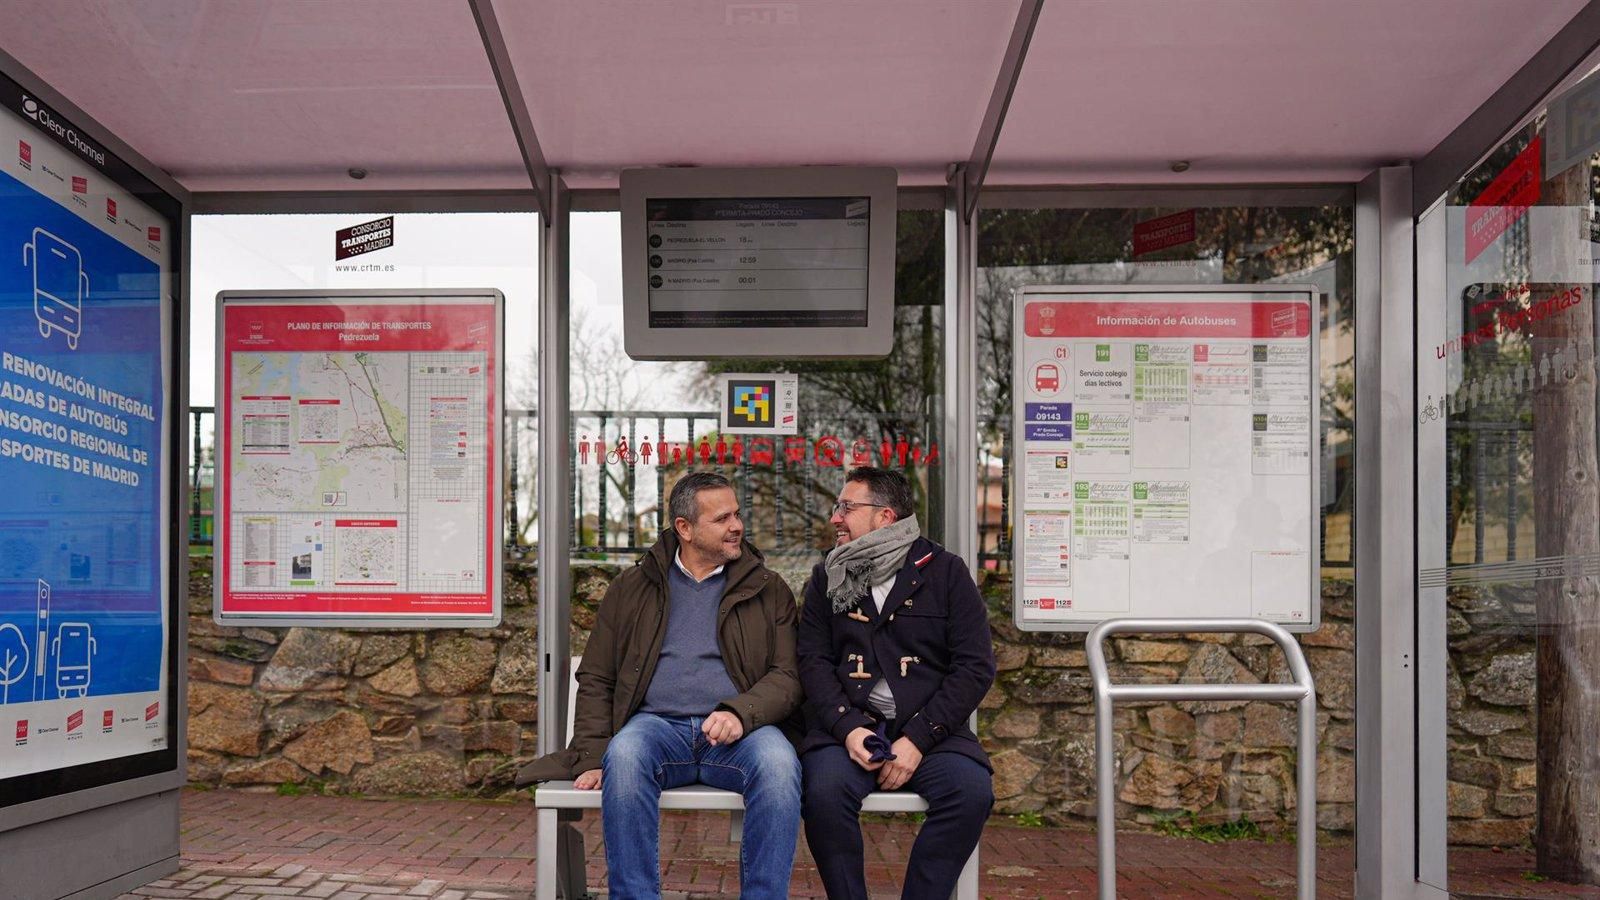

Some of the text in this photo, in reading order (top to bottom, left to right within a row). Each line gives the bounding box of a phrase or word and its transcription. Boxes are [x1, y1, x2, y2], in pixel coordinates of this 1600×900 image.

[38, 109, 105, 166] Clear Channel
[351, 218, 391, 236] CONSORCIO
[341, 228, 391, 249] TRANSPORTES
[364, 237, 391, 252] MADRID
[335, 264, 395, 272] www.crtm.es
[287, 320, 432, 330] PLANO DE INFORMACIÓN DE TRANSPORTES
[1096, 315, 1237, 326] Información de Autobuses
[338, 332, 380, 341] Pedrezuela
[1056, 347, 1067, 359] C1
[1079, 369, 1127, 379] Servicio colegio
[2, 351, 155, 422] RENOVACIÓN INTEGRAL
[1099, 378, 1122, 387] lectivos
[0, 380, 128, 436] ADAS DE AUTOBÚS
[1036, 412, 1061, 420] 09143
[70, 429, 131, 462] REGIONAL
[132, 449, 148, 466] DE
[0, 438, 139, 487] SPORTES DE MADRID
